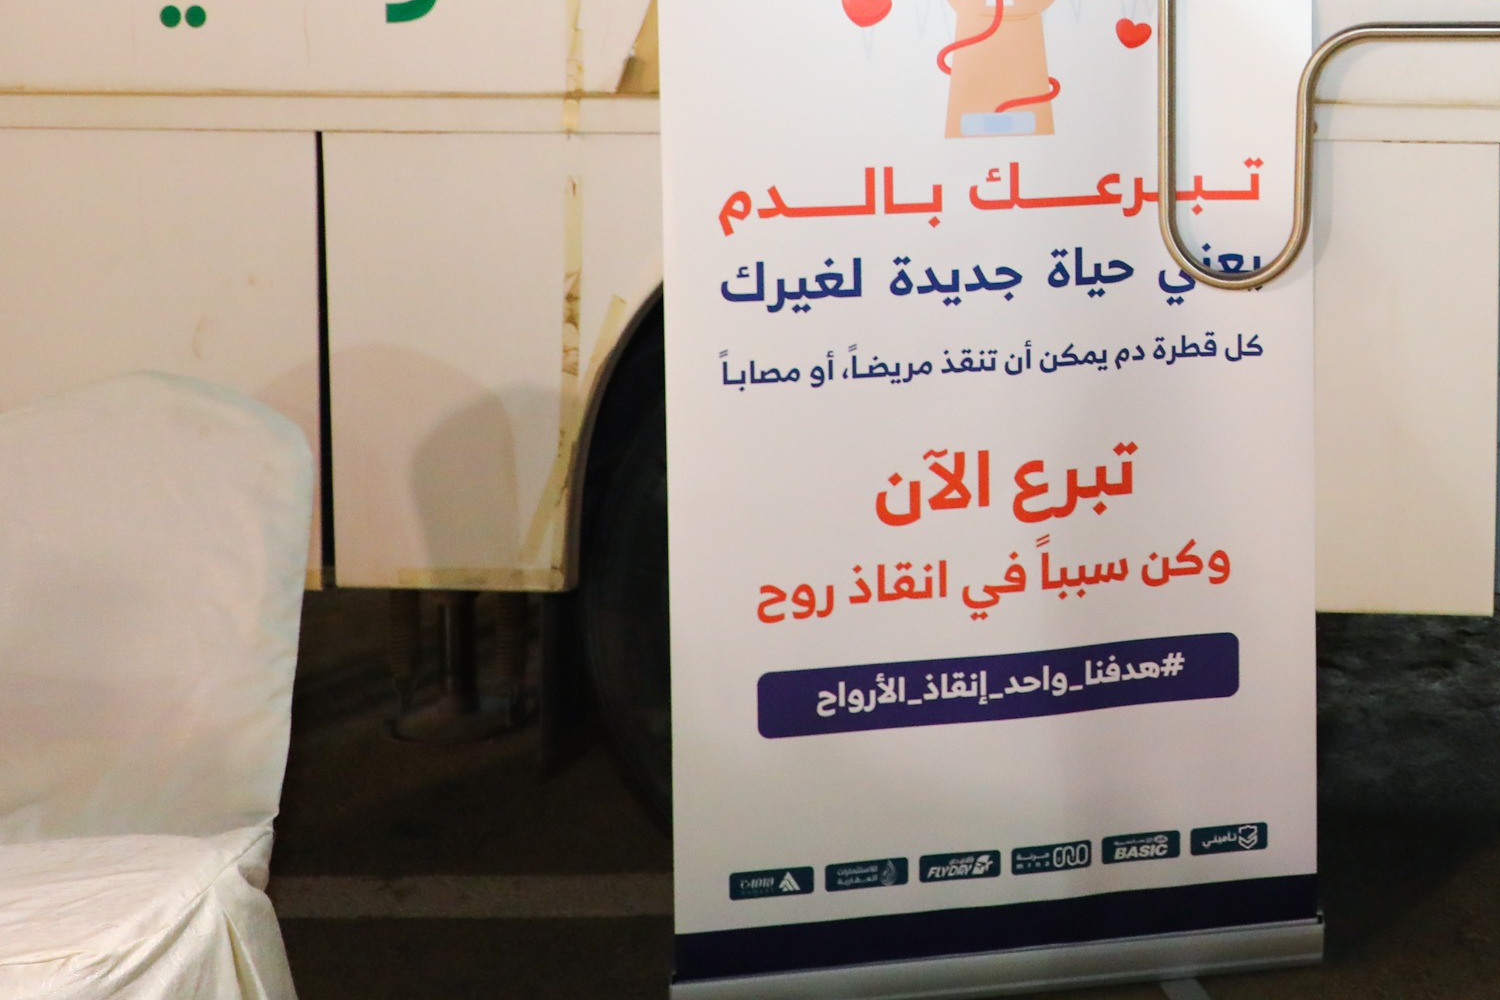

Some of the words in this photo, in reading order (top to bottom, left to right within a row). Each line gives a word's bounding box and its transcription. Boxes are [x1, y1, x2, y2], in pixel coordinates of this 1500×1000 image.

[720, 257, 863, 314] لغيرك
[889, 256, 1023, 307] جديدة
[1047, 246, 1135, 298] حياة
[941, 348, 998, 374] تنقذ
[1004, 339, 1032, 376] أن
[1039, 343, 1108, 374] يمكن
[1114, 341, 1145, 370] دم
[1152, 331, 1217, 366] قطرة
[1224, 333, 1264, 362] كل
[809, 350, 834, 388] أو
[875, 449, 990, 527] الآن
[1013, 442, 1138, 524] تبرع
[849, 560, 948, 605] انقاذ
[1141, 539, 1231, 587] وكن
[757, 583, 835, 624] روح
[962, 551, 1027, 621] في
[1114, 844, 1169, 861] BASIC
